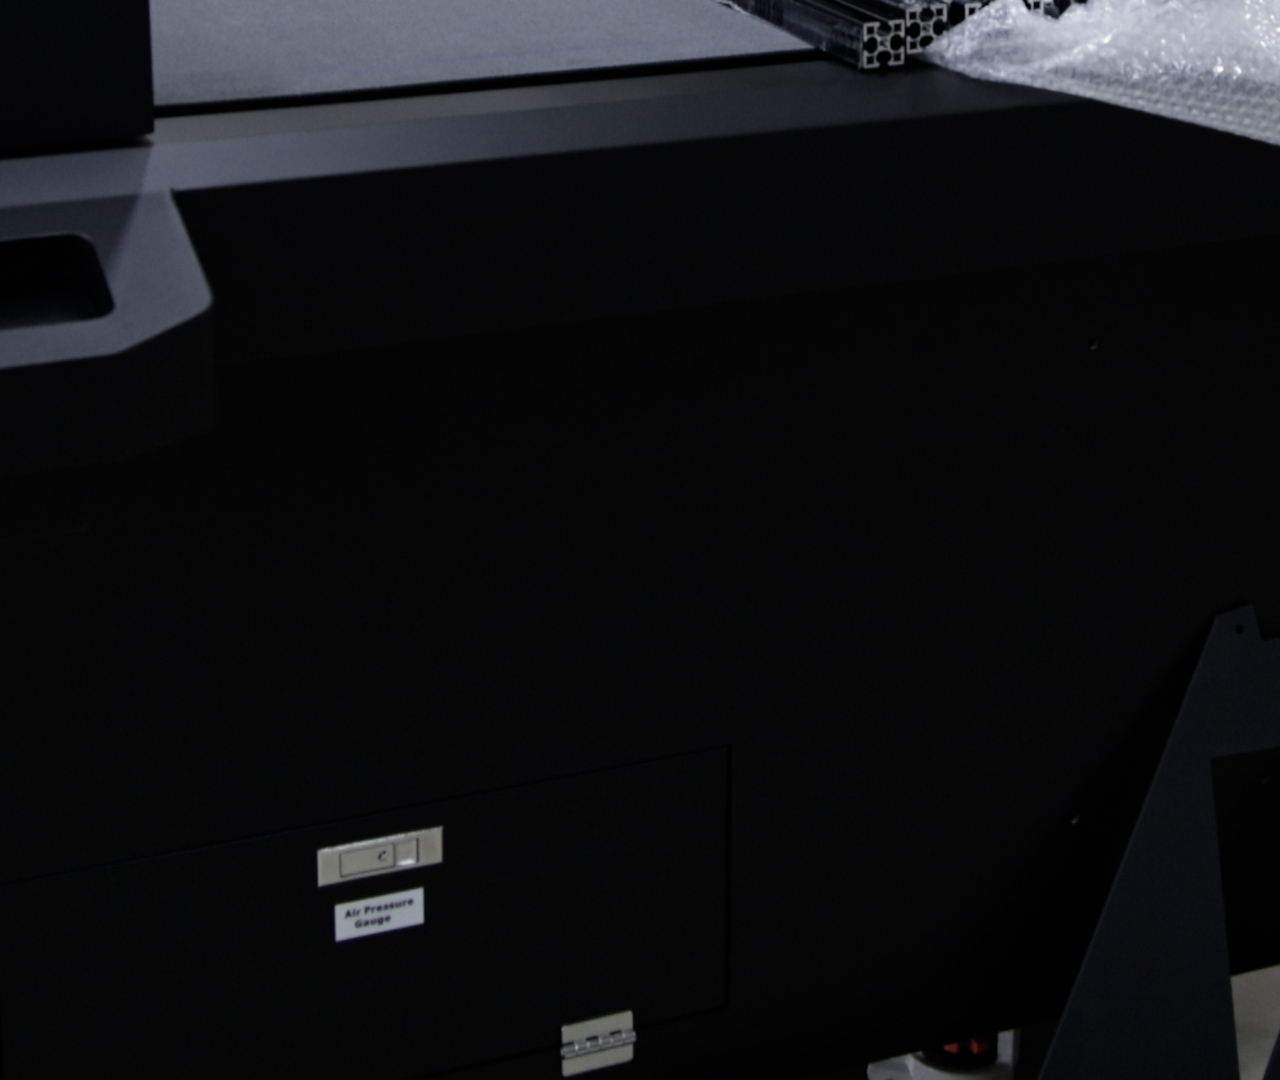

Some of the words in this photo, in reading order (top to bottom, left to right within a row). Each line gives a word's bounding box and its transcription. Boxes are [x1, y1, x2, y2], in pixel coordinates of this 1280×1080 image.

[344, 908, 361, 919] Air
[364, 898, 414, 915] Pressure
[354, 915, 391, 929] Gauge
